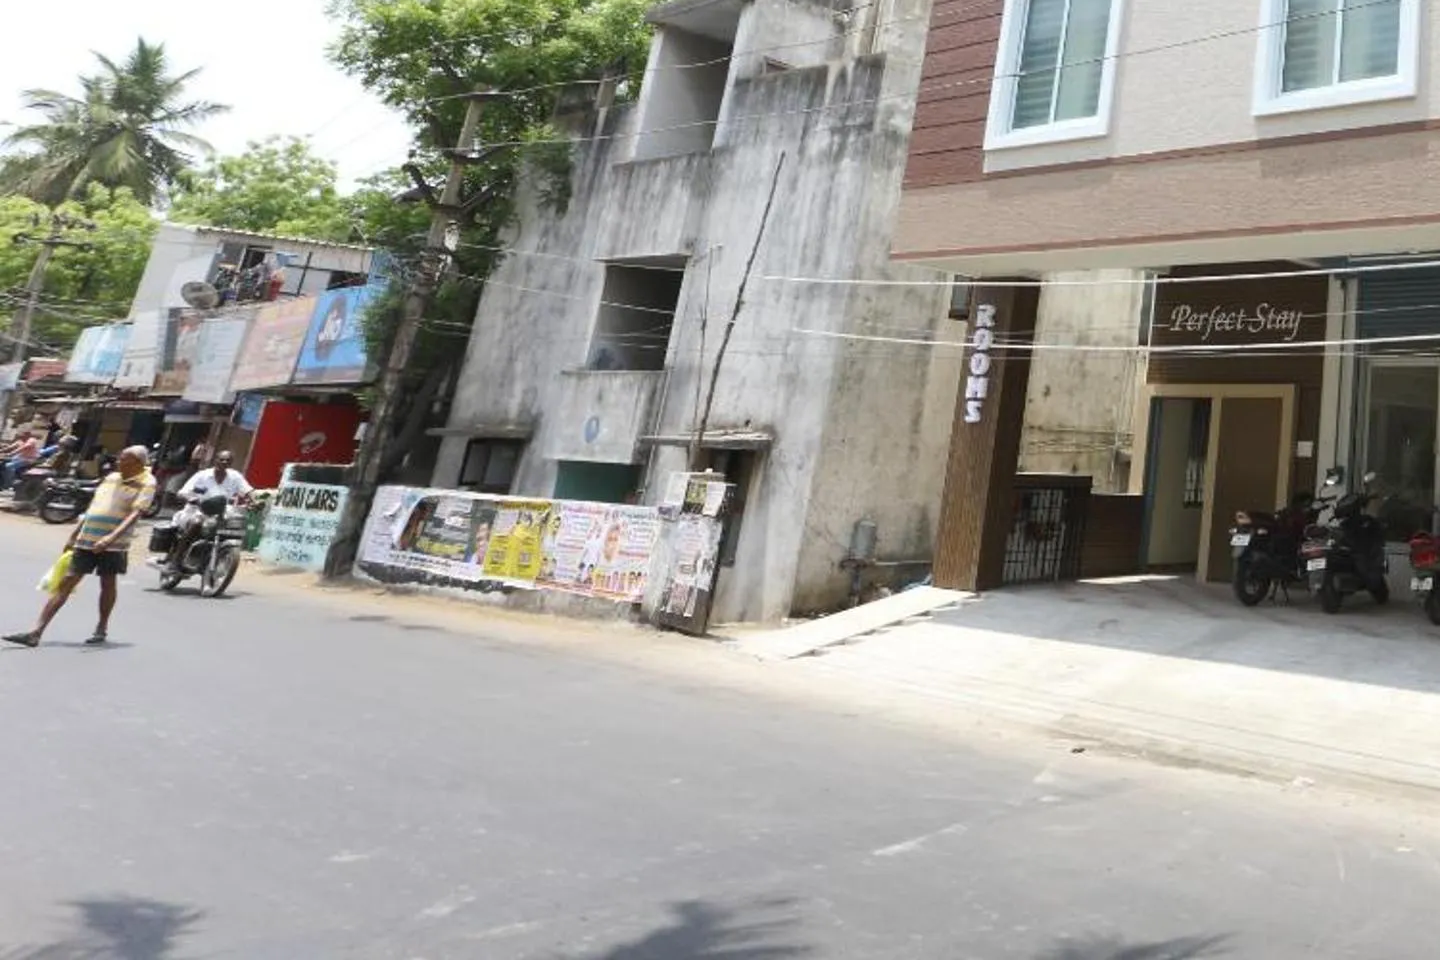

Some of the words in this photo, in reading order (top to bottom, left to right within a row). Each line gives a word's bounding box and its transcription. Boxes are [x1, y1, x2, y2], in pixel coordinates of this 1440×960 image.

[1170, 304, 1247, 340] Perfect
[1250, 303, 1302, 340] Stay
[965, 304, 996, 424] ROOMS
[305, 488, 339, 512] CARS
